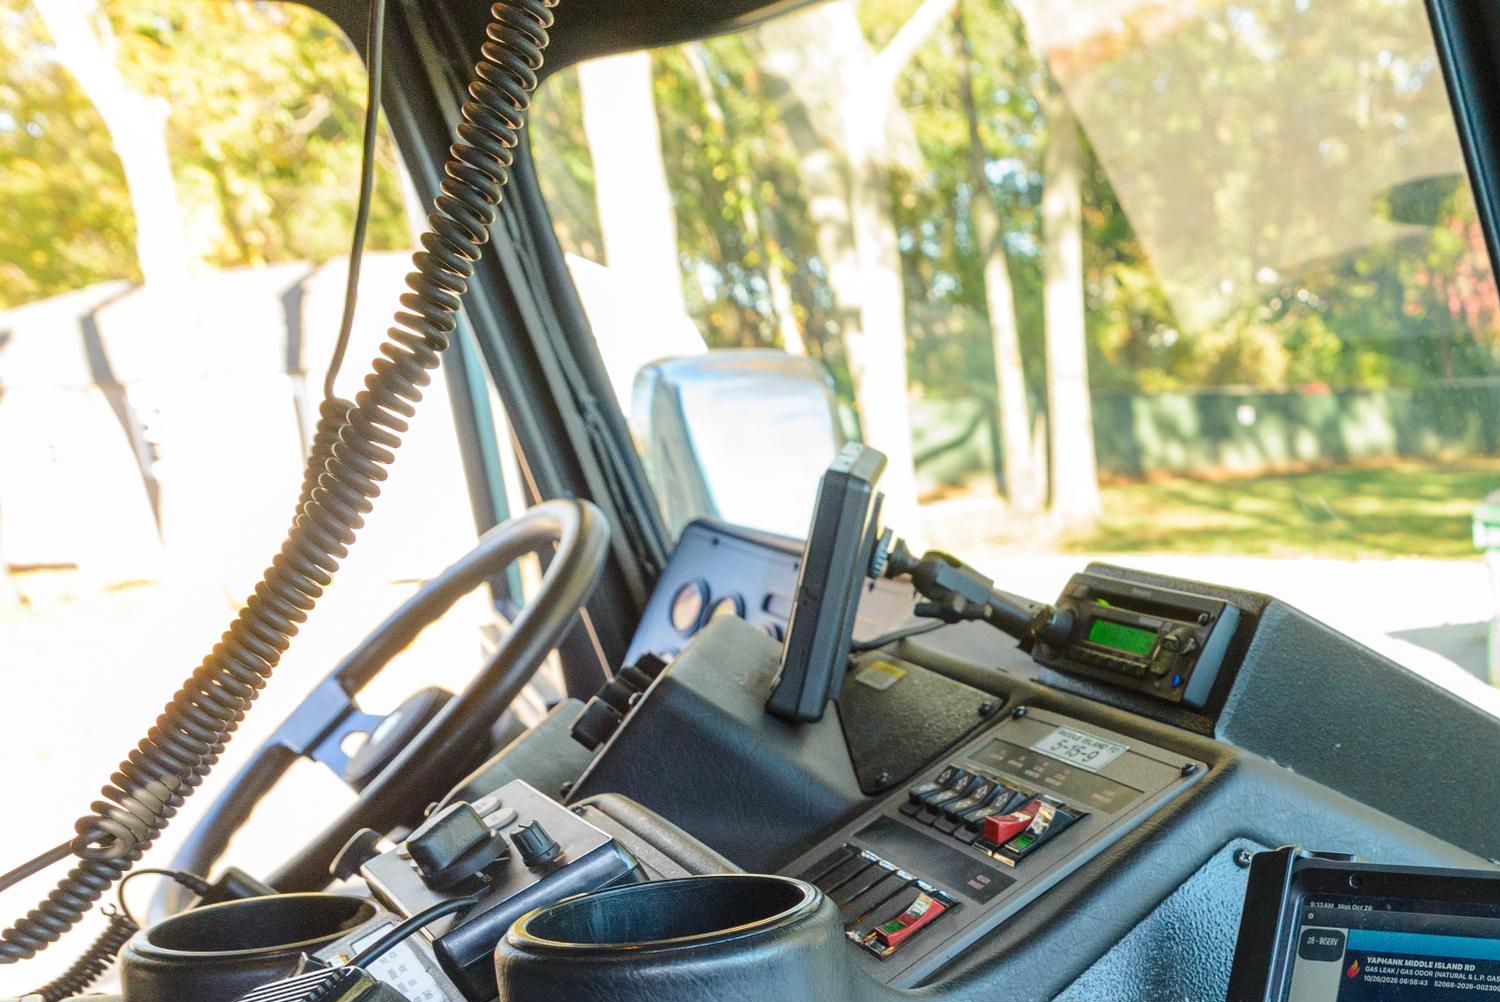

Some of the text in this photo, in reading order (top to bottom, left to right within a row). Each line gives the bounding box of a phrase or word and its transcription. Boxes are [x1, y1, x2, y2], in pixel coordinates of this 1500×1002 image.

[1050, 739, 1100, 762] 5-15-9
[1338, 903, 1351, 911] Mon
[1366, 956, 1476, 972] YAPHANK MIDDLE ISLAND RD
[1400, 968, 1414, 976] GAS
[1434, 971, 1467, 980] (NATURAL
[1474, 974, 1486, 982] L.P.
